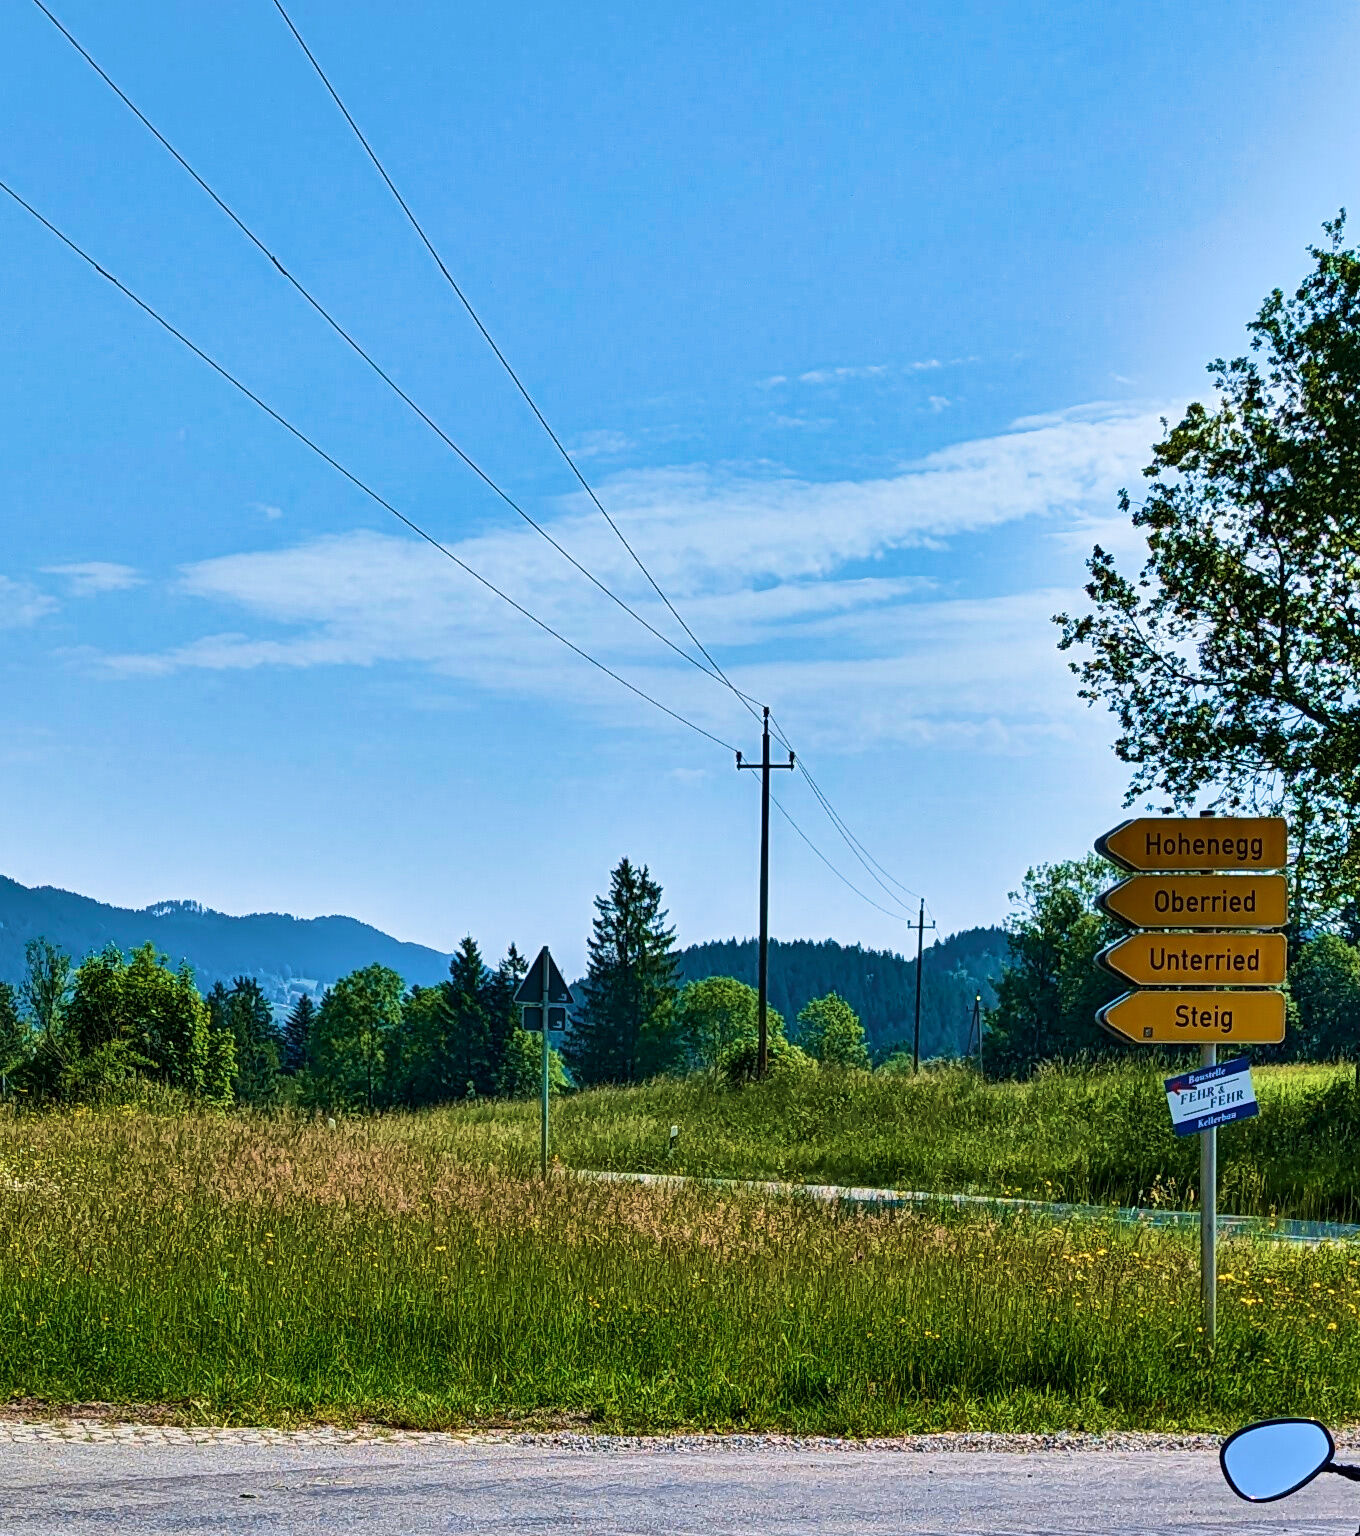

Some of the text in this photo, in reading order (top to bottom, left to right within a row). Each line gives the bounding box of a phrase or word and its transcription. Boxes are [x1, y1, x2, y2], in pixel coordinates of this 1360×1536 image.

[1145, 832, 1263, 861] Hohenegg
[1154, 889, 1257, 913] Oberried
[1149, 947, 1260, 971] Unterried
[1174, 1005, 1233, 1034] Steig
[1188, 1067, 1226, 1085] Baustelle
[1180, 1085, 1225, 1106] FEHR &
[1210, 1089, 1244, 1109] FEHR
[1197, 1111, 1237, 1129] Kellerbau
